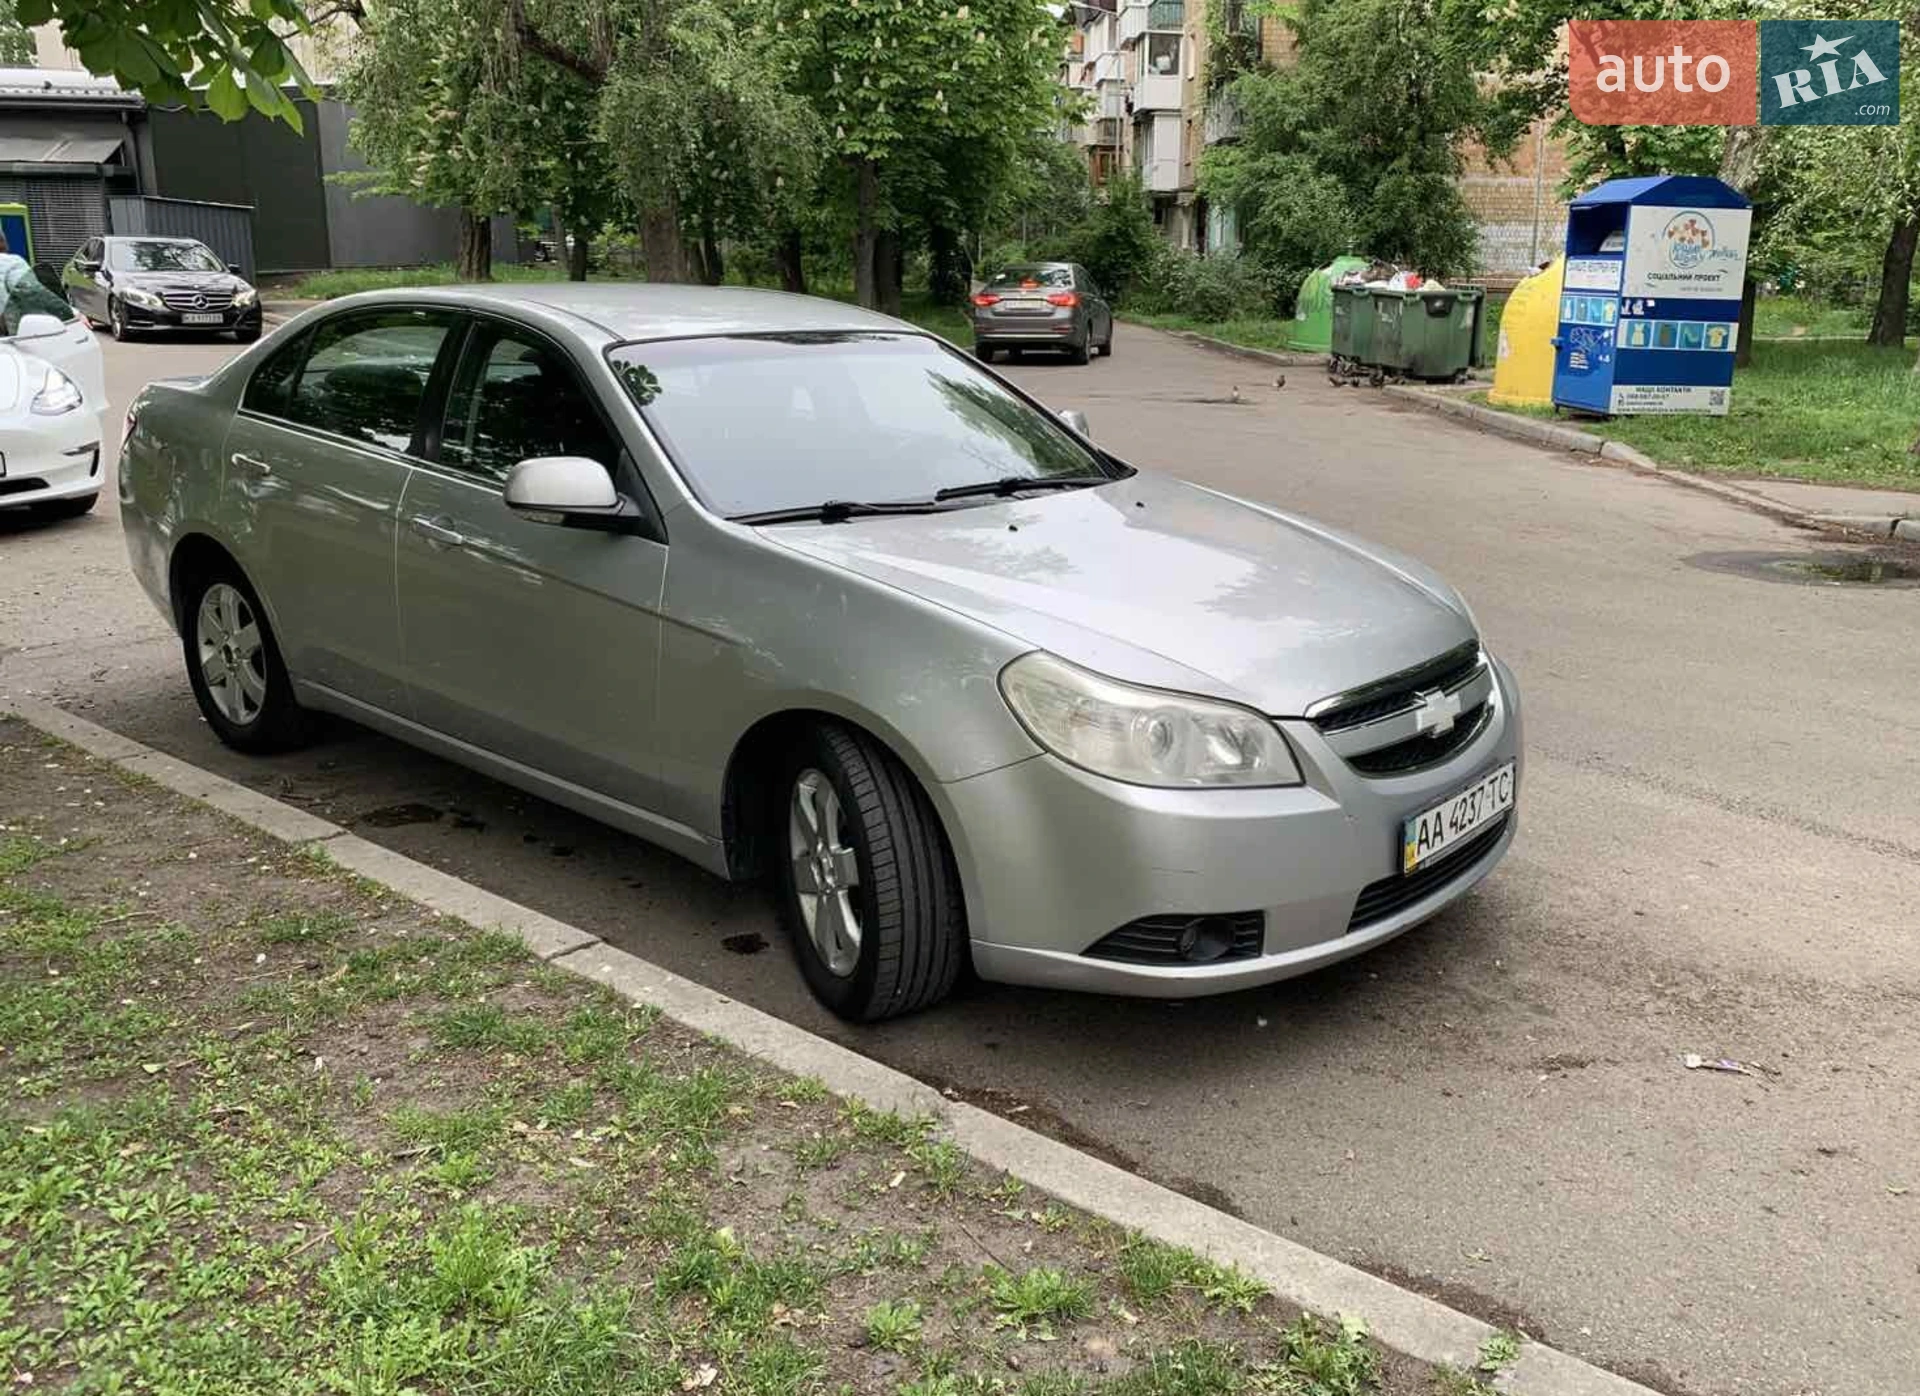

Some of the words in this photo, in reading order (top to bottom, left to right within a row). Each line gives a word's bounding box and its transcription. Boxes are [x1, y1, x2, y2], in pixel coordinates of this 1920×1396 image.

[1417, 811, 1444, 855] AA
[1449, 785, 1485, 835] 4237
[1488, 771, 1509, 810] TC
